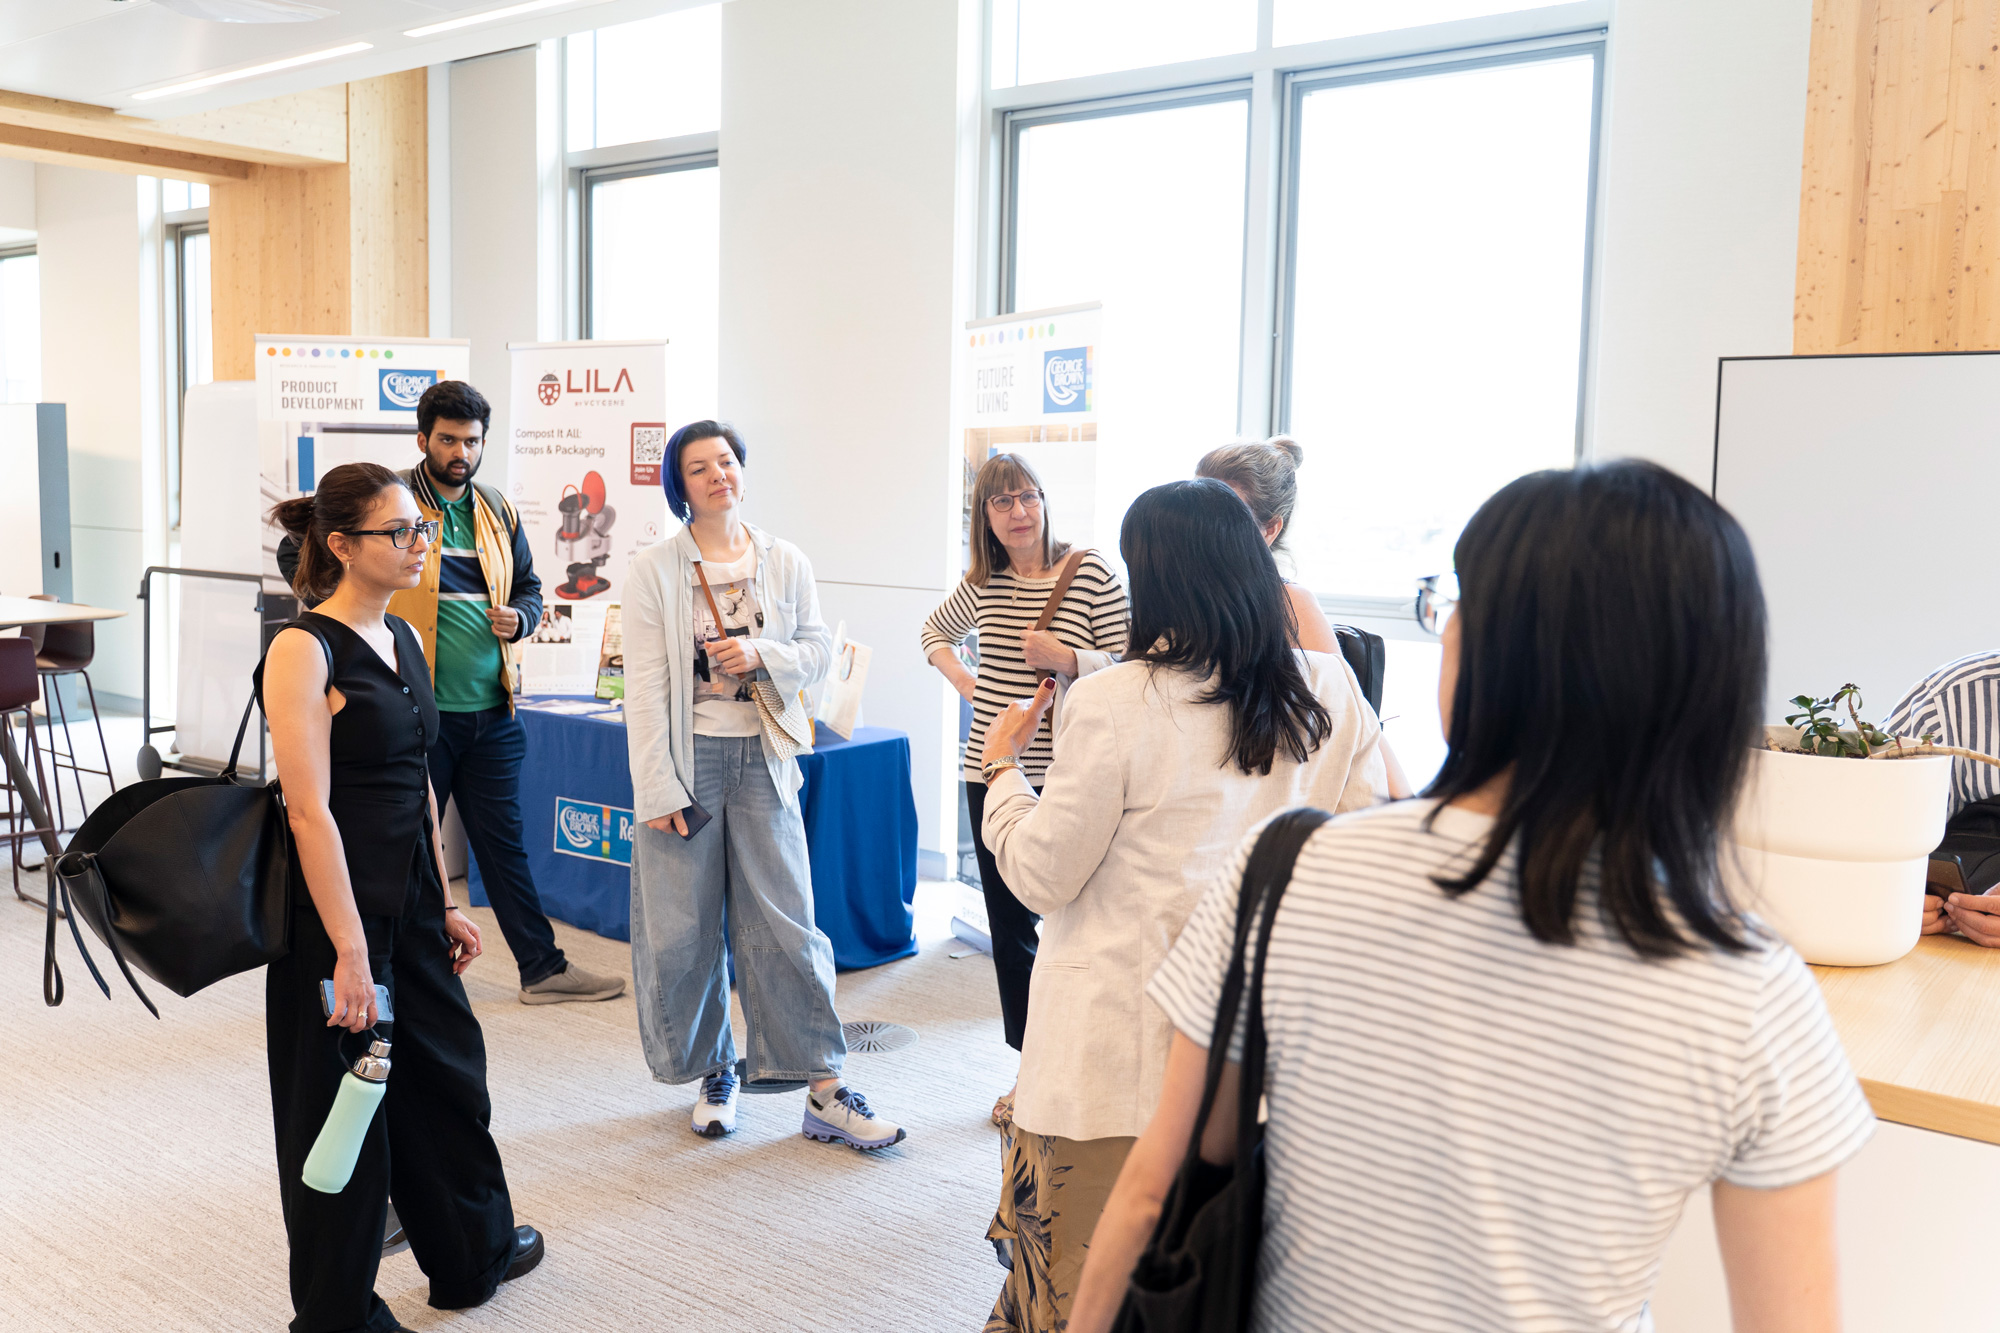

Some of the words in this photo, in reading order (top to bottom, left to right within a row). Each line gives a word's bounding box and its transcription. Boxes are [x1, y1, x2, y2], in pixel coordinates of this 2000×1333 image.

[1051, 359, 1084, 374] GEORGE
[389, 375, 432, 387] GEORGE
[566, 368, 634, 393] LILA
[977, 365, 1015, 390] FUTURE
[1054, 371, 1085, 386] BROWN
[281, 380, 338, 394] PRODUCT
[281, 396, 365, 410] DEVELOPMENT
[976, 391, 1009, 414] LIVING
[515, 428, 555, 440] Compost
[557, 428, 564, 439] It
[566, 428, 582, 439] All:
[514, 445, 545, 457] Scraps
[546, 445, 553, 455] &
[555, 445, 605, 458] Packaging
[634, 474, 651, 482] Today
[565, 809, 600, 826] GEORGE
[569, 820, 601, 836] BROWN
